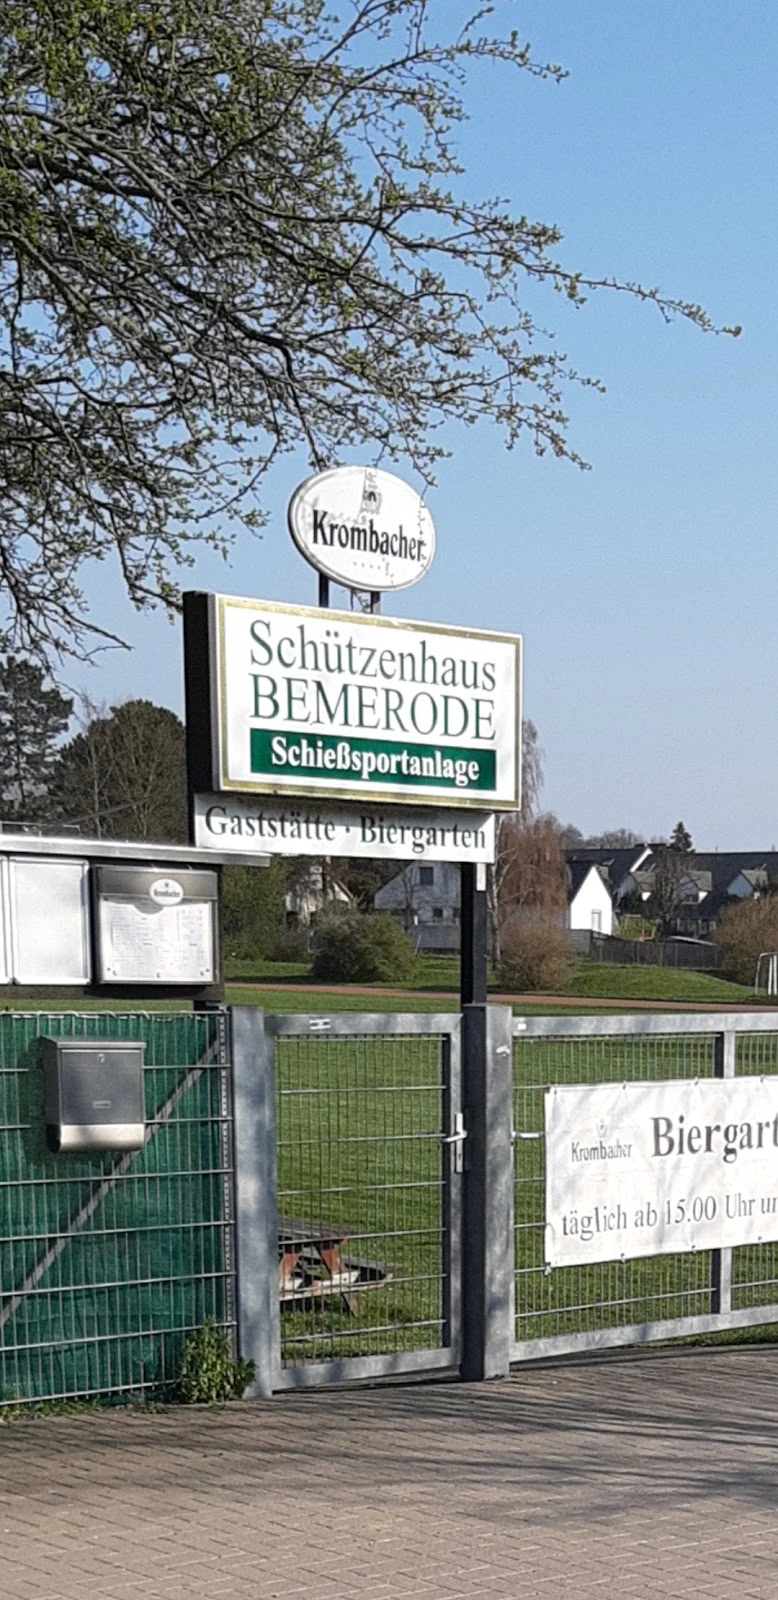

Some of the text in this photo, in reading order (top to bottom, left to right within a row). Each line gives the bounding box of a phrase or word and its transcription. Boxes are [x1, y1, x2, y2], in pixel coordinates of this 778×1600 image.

[312, 508, 425, 562] Krombacher
[250, 619, 497, 692] Schützenhaus
[249, 673, 497, 742] BEMERODE
[271, 736, 480, 787] Schießsportanlage
[204, 805, 486, 854] Gaststätte Biergarten
[562, 1204, 627, 1242] täglich
[634, 1202, 658, 1228] ab
[665, 1195, 717, 1225] 15.00
[725, 1192, 755, 1220] Uhr
